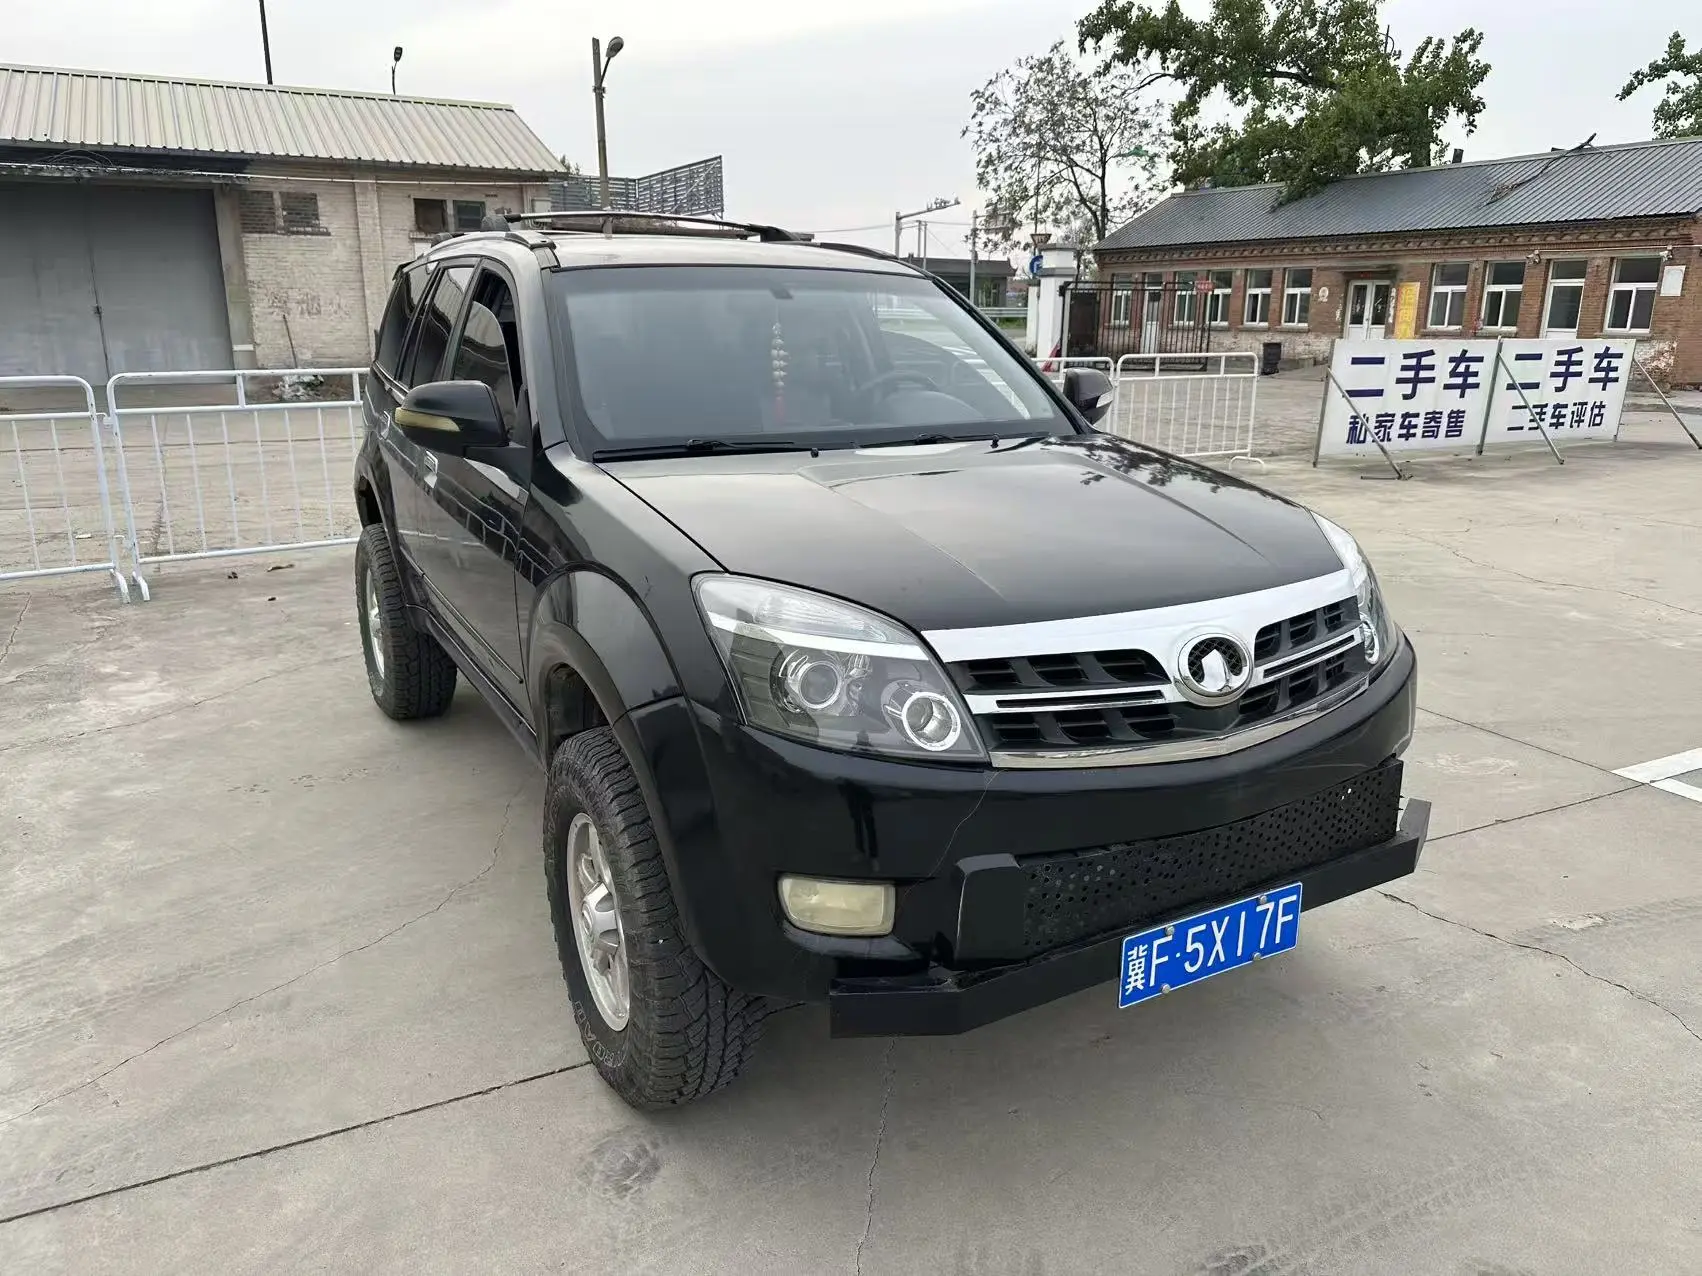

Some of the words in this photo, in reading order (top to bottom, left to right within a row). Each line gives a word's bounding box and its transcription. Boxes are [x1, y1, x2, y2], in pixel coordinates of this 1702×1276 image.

[1343, 348, 1485, 401] 二手车
[1505, 345, 1624, 393] 二手车
[1346, 408, 1466, 444] 私家车寄售
[1506, 400, 1607, 432] 二手车评估
